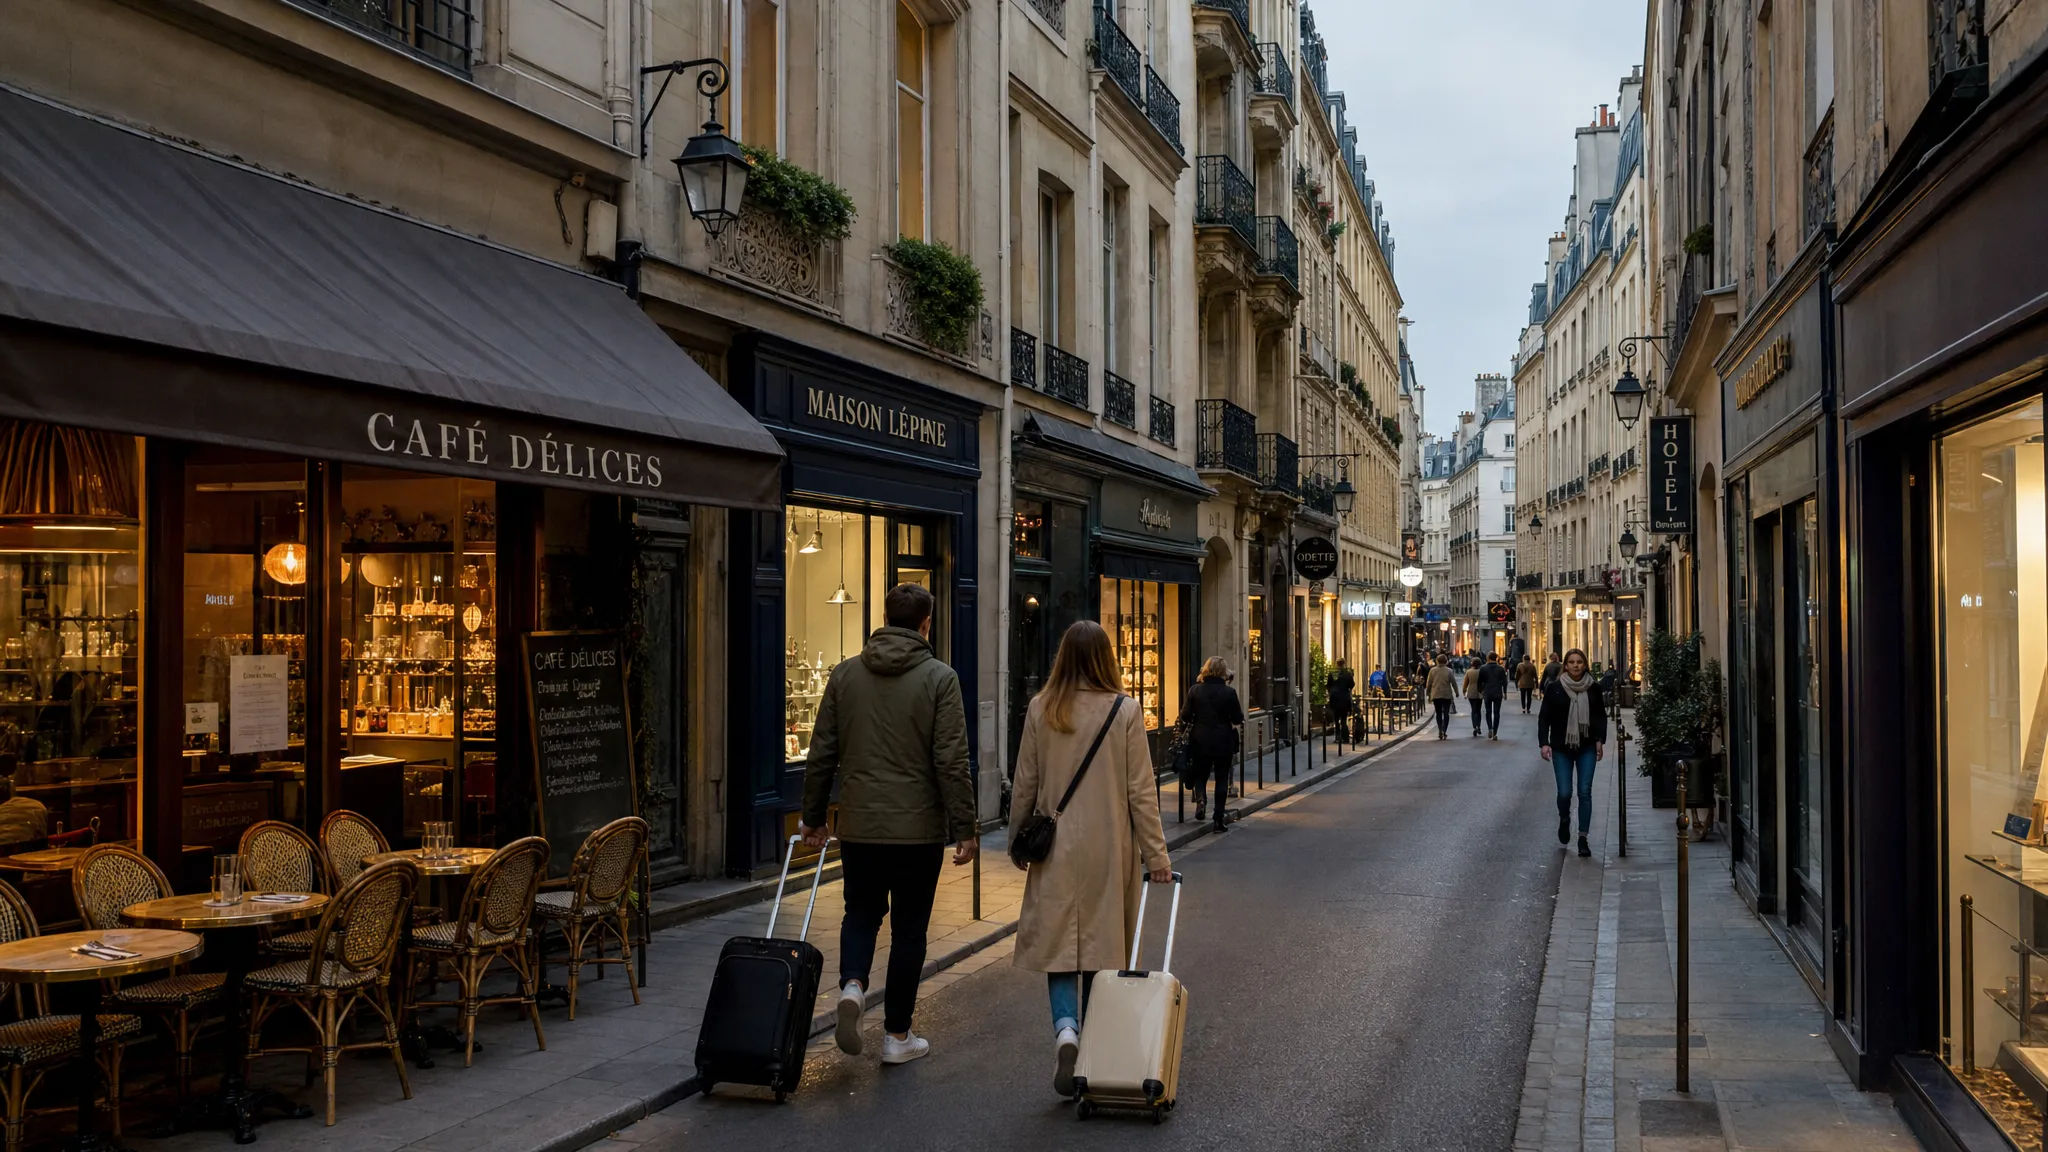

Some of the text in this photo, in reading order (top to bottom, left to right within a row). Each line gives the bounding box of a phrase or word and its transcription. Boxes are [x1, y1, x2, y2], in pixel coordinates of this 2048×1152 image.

[807, 387, 882, 432] MAISON
[367, 412, 662, 487] CAFÉ DÉLICES
[1663, 425, 1678, 512] HOTEL
[1296, 552, 1335, 562] ODETTE
[534, 648, 616, 670] CAFÉ DÉLICES
